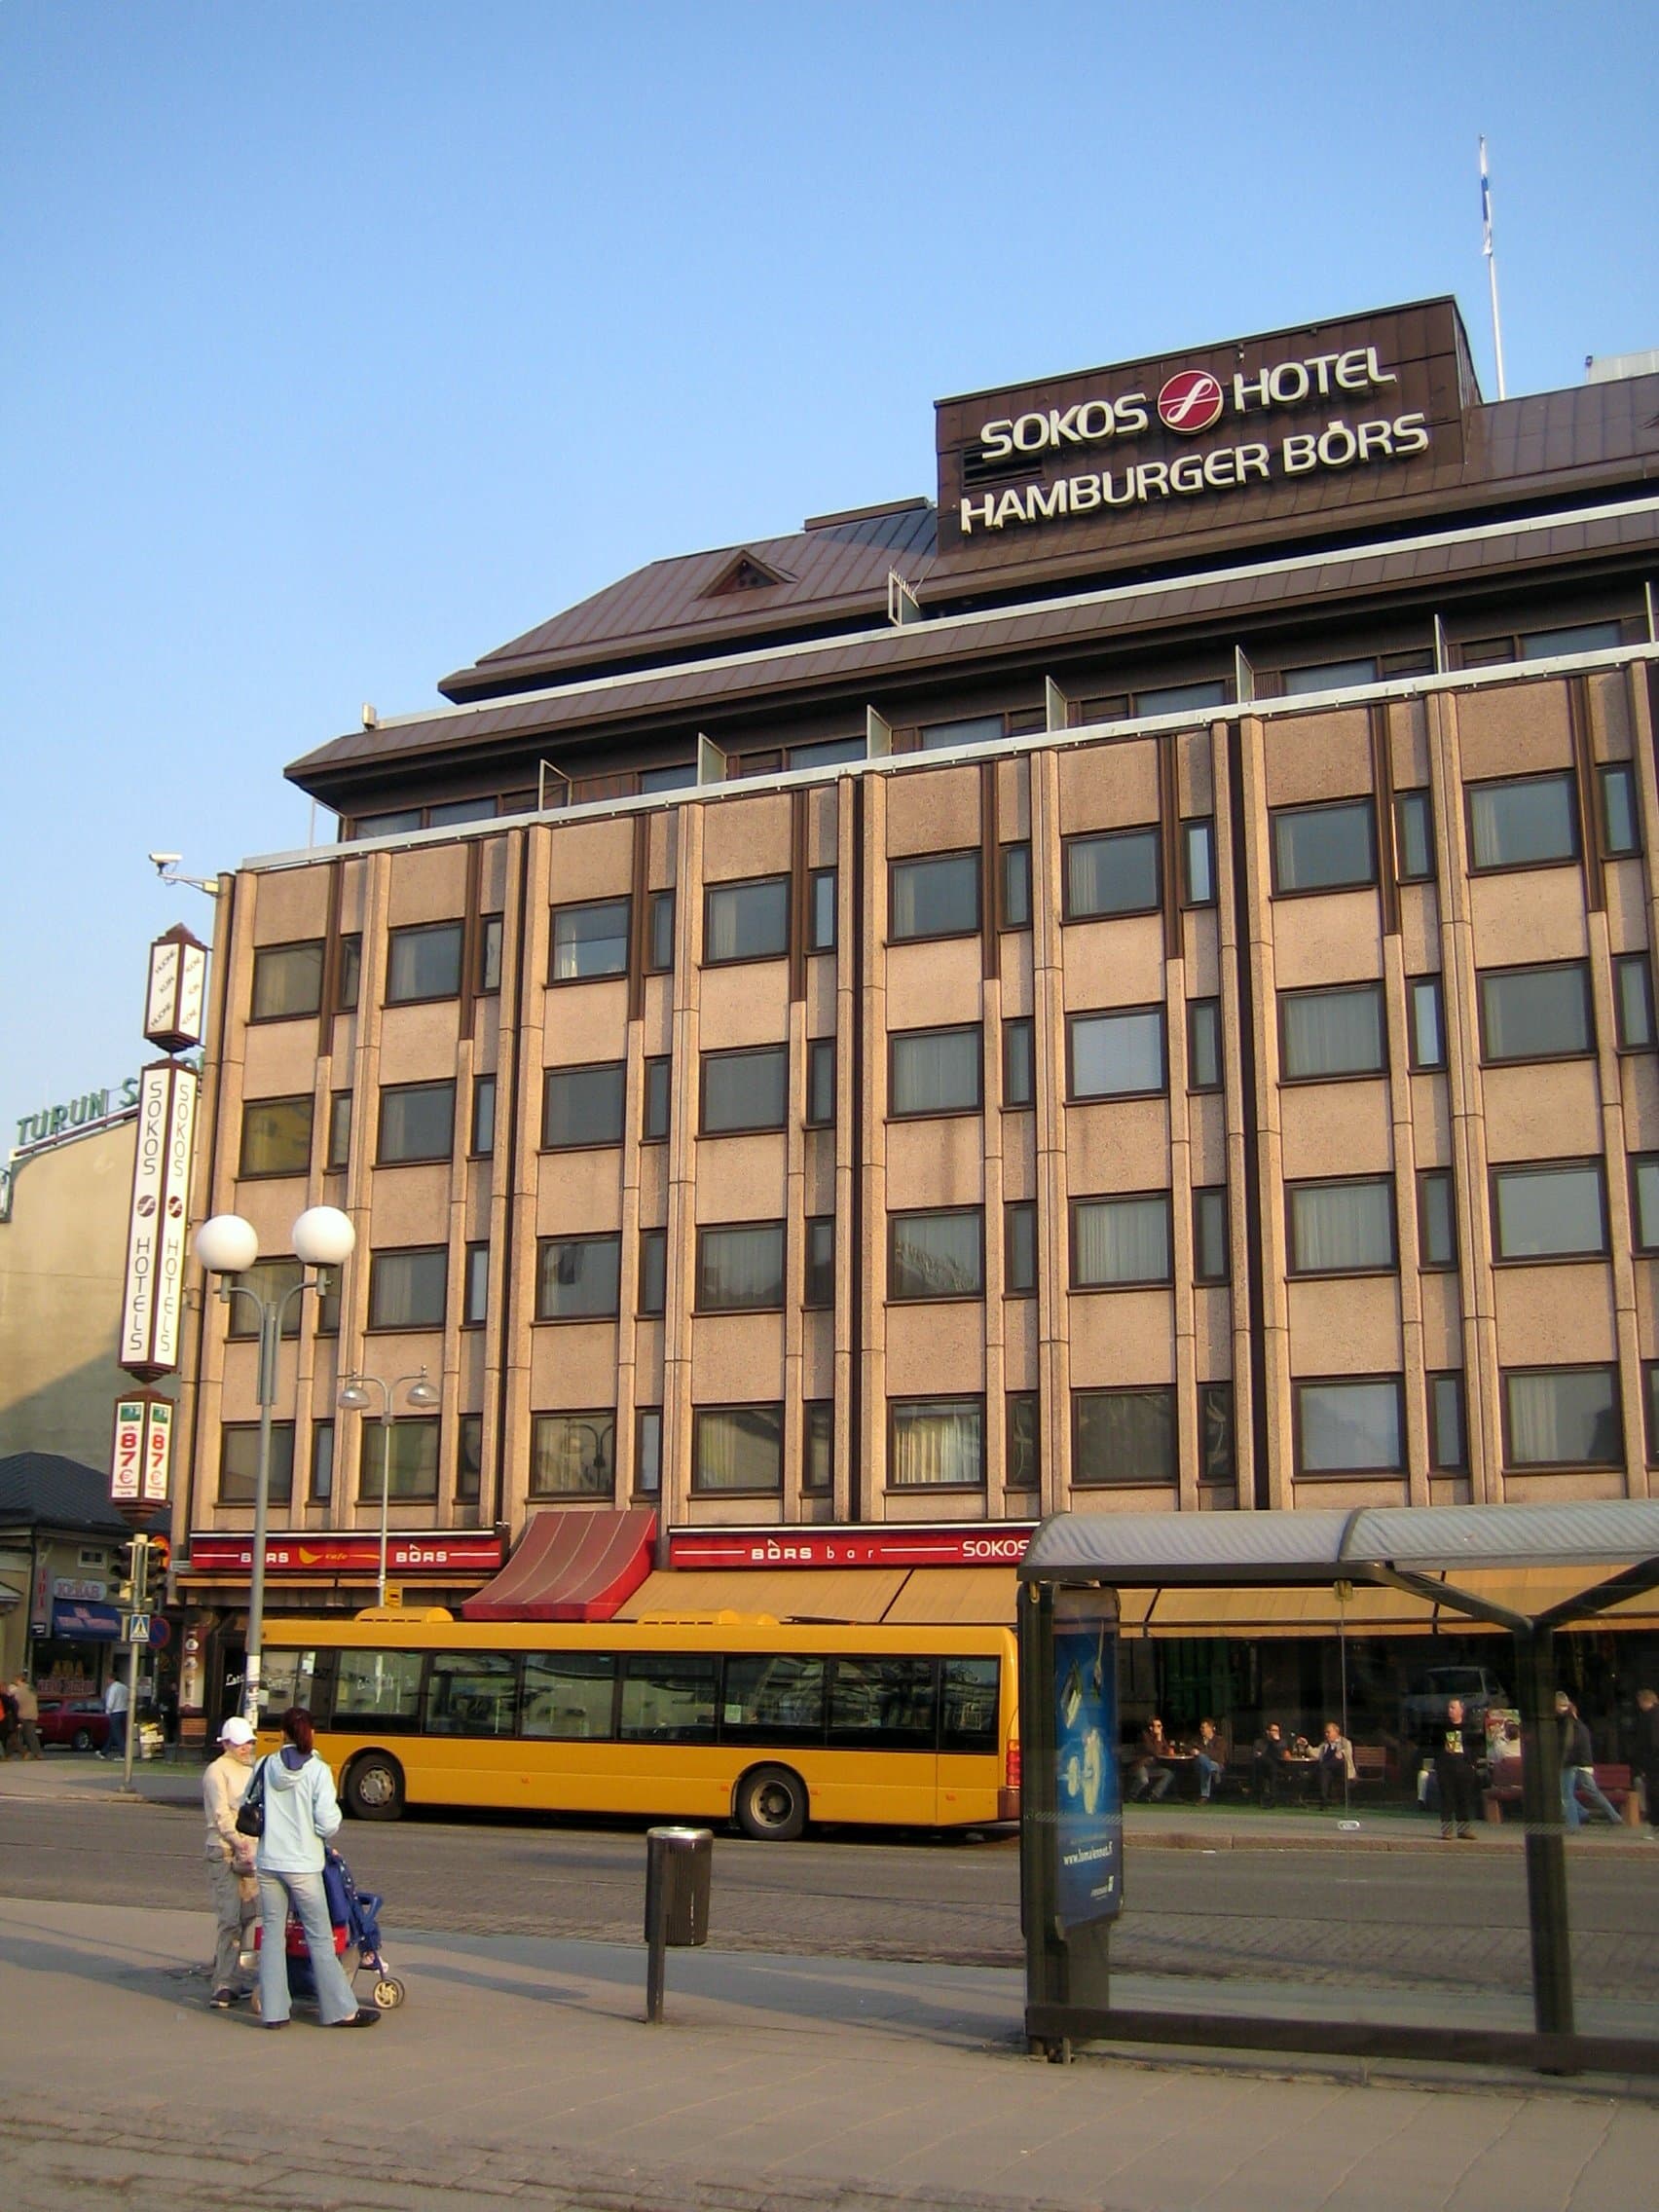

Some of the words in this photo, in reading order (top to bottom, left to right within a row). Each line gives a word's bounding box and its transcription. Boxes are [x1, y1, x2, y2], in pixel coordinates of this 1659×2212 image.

[980, 392, 1148, 461] SOKOS
[1234, 347, 1398, 413] HOTEL
[960, 443, 1271, 535] HAMBURGER
[17, 1088, 107, 1146] TURUN
[143, 1081, 164, 1176] SOKOS
[174, 1085, 189, 1177] SOKOS
[130, 1237, 151, 1350] HOTELS
[160, 1239, 178, 1352] HOTELS
[240, 1551, 289, 1564] BRS
[962, 1539, 1029, 1557] SOKOS
